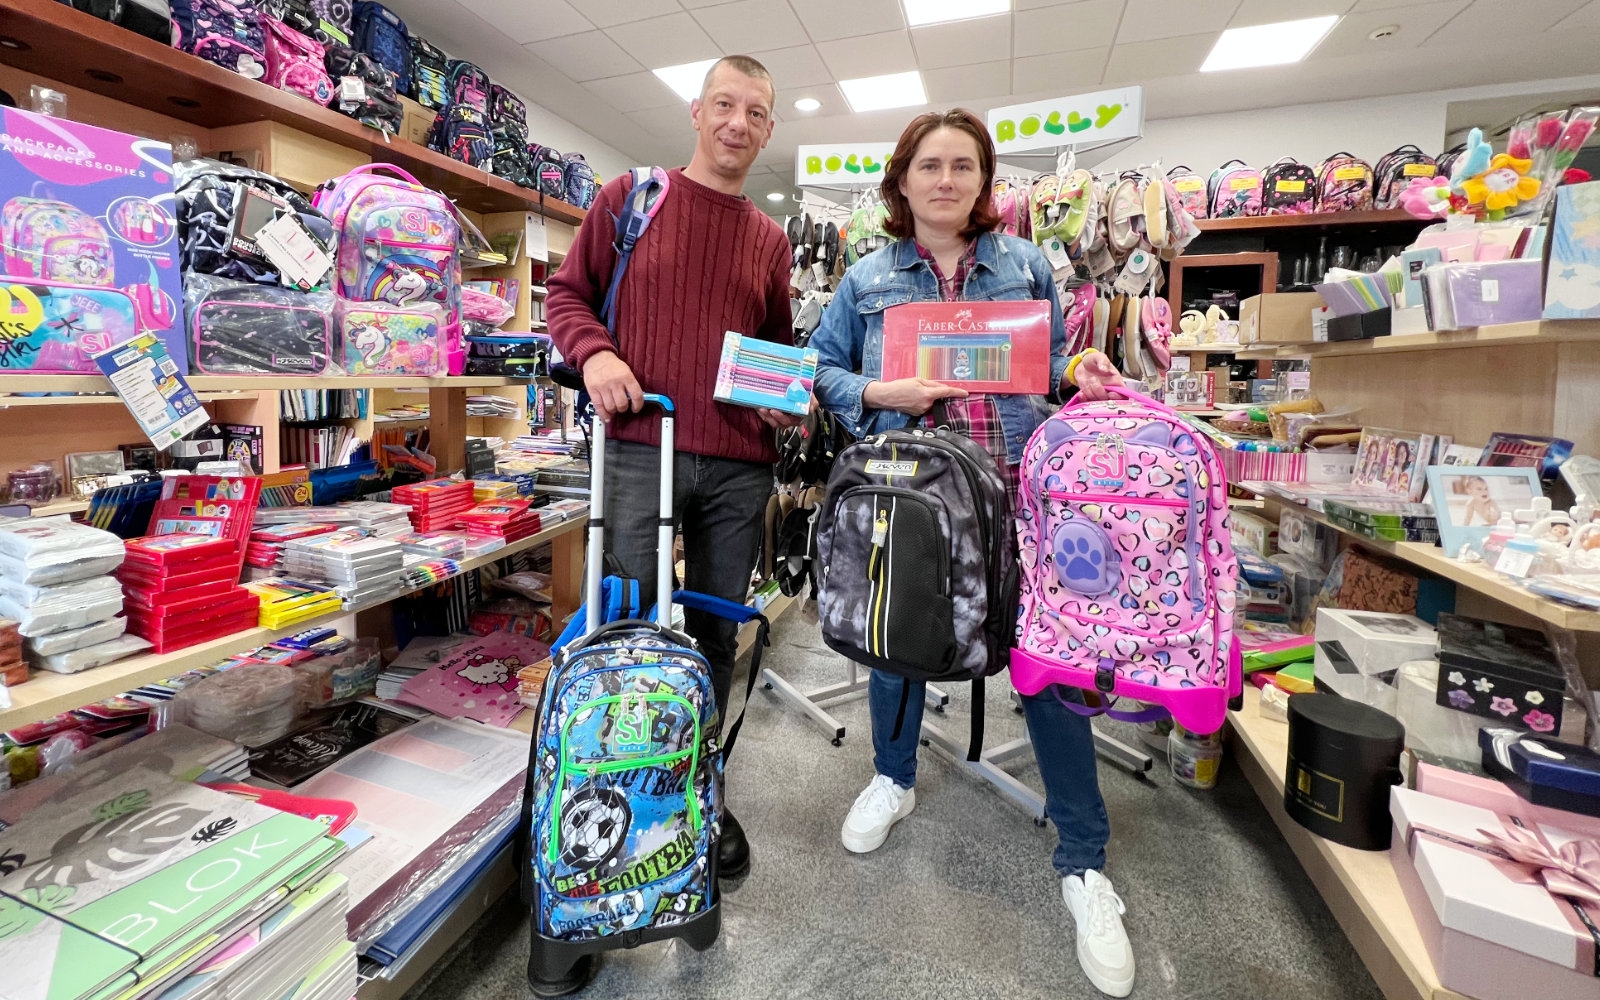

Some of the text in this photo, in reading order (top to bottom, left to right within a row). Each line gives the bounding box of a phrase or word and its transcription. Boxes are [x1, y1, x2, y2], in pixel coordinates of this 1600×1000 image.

[996, 104, 1122, 143] ROLLY
[2, 133, 96, 159] BACKPACKS
[2, 143, 146, 178] AND ACCESSORIES
[806, 153, 892, 175] ROLL
[1090, 452, 1124, 479] SJ
[615, 713, 649, 745] SJ
[99, 832, 289, 946] BLOK
[556, 867, 597, 893] BEST
